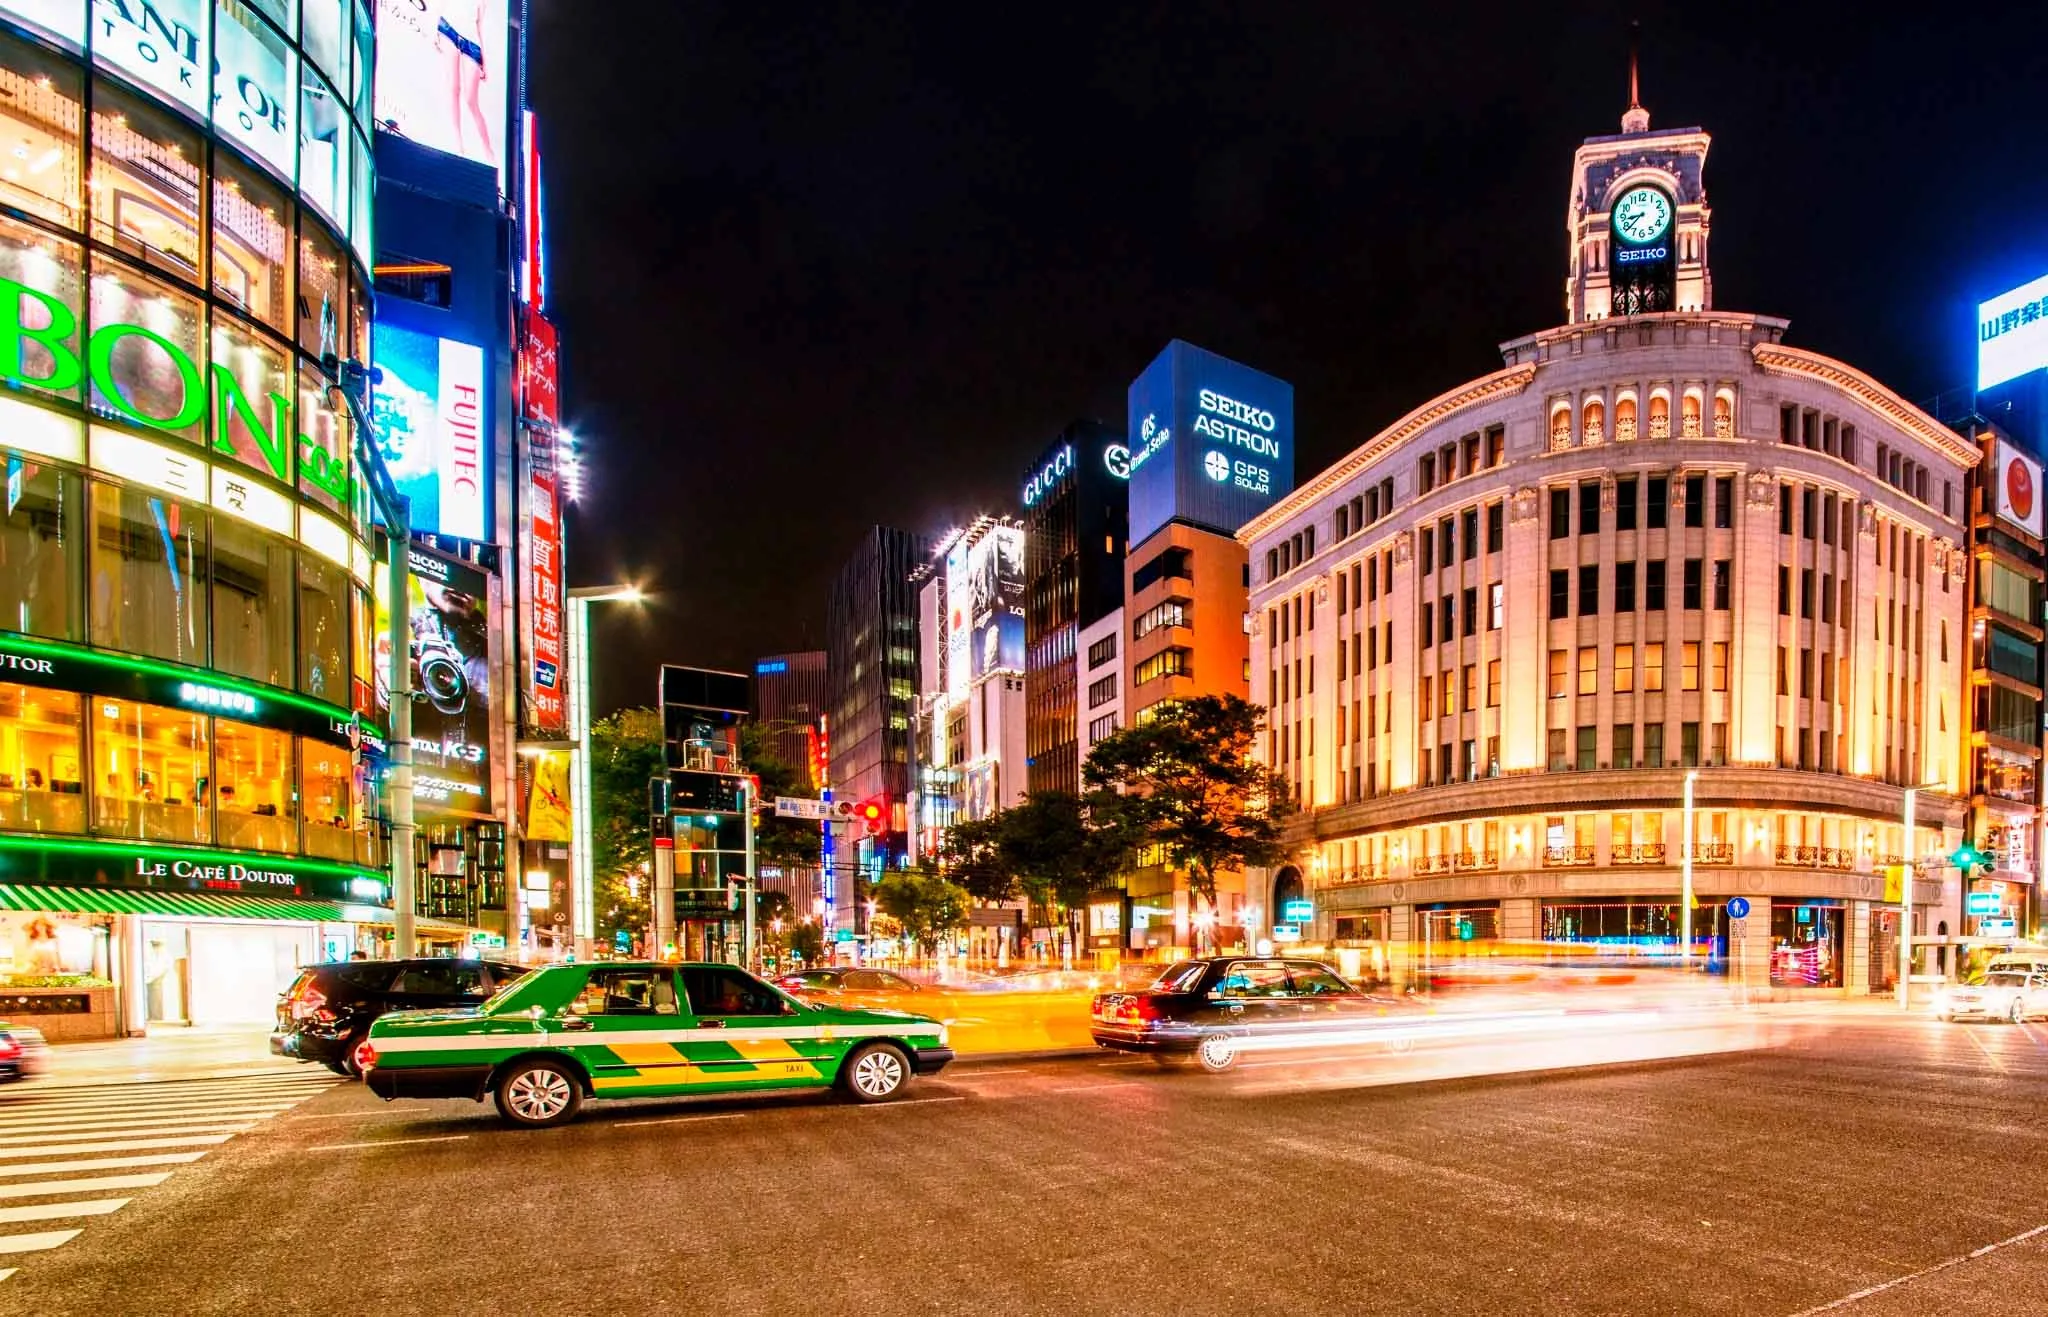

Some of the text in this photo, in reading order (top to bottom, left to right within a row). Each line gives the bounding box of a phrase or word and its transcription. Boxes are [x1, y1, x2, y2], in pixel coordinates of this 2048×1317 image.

[103, 18, 254, 131] TOKYO
[1630, 195, 1636, 205] 11
[1639, 193, 1646, 202] 12
[1650, 194, 1654, 204] 1
[1622, 204, 1630, 212] 10
[1656, 200, 1662, 209] 2
[1620, 213, 1626, 222] 9
[1658, 210, 1664, 218] 3
[1622, 221, 1630, 231] 8
[1654, 219, 1662, 227] 4
[1631, 228, 1638, 236] 7
[1638, 229, 1646, 238] 6
[1648, 226, 1654, 235] 5
[1619, 248, 1666, 262] SEIKO
[1199, 388, 1276, 432] SEIKO
[453, 383, 477, 497] FUJITEC
[1193, 413, 1280, 459] ASTRON
[1024, 444, 1072, 504] GUCCI
[1234, 460, 1270, 484] GPS
[164, 455, 248, 513] 三愛
[1234, 475, 1270, 496] SOLAR
[408, 550, 448, 574] RICOH
[136, 857, 168, 877] LE
[229, 864, 296, 886] DOUTOR
[784, 1062, 804, 1073] TAXI
